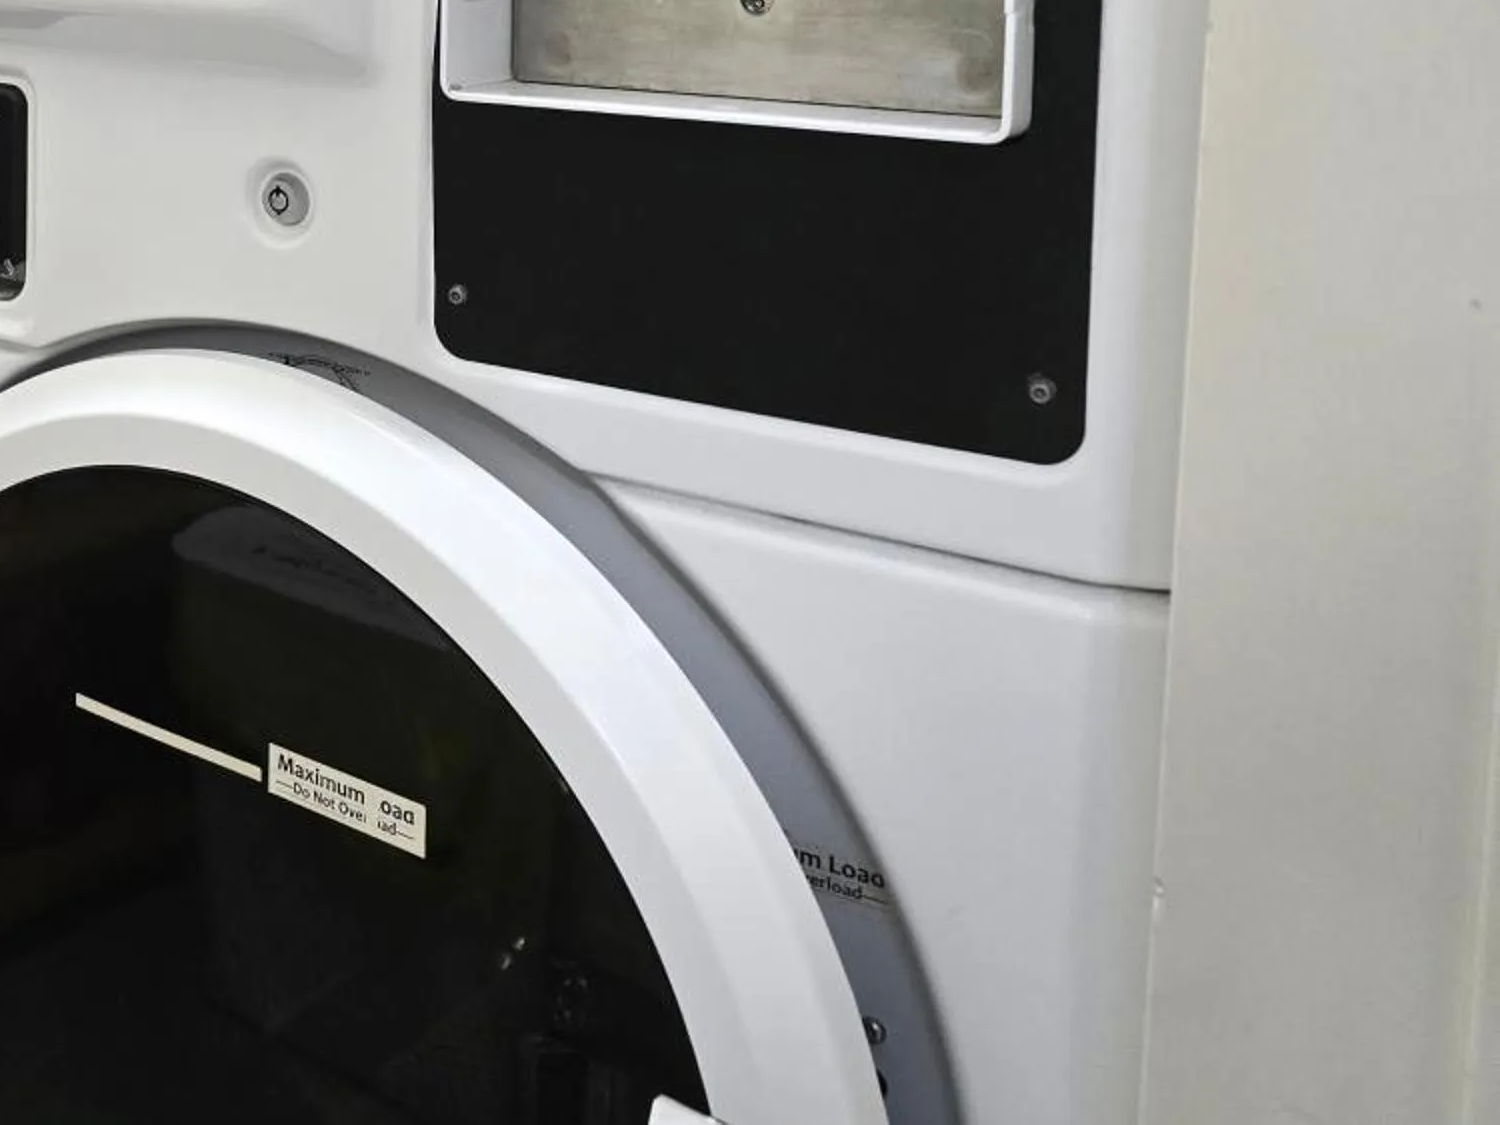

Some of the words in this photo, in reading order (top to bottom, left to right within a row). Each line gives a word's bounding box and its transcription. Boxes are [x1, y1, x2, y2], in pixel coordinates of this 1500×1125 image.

[278, 753, 365, 805] Maximum
[378, 799, 415, 825] oad
[292, 781, 311, 799] Do
[313, 790, 335, 810] Not
